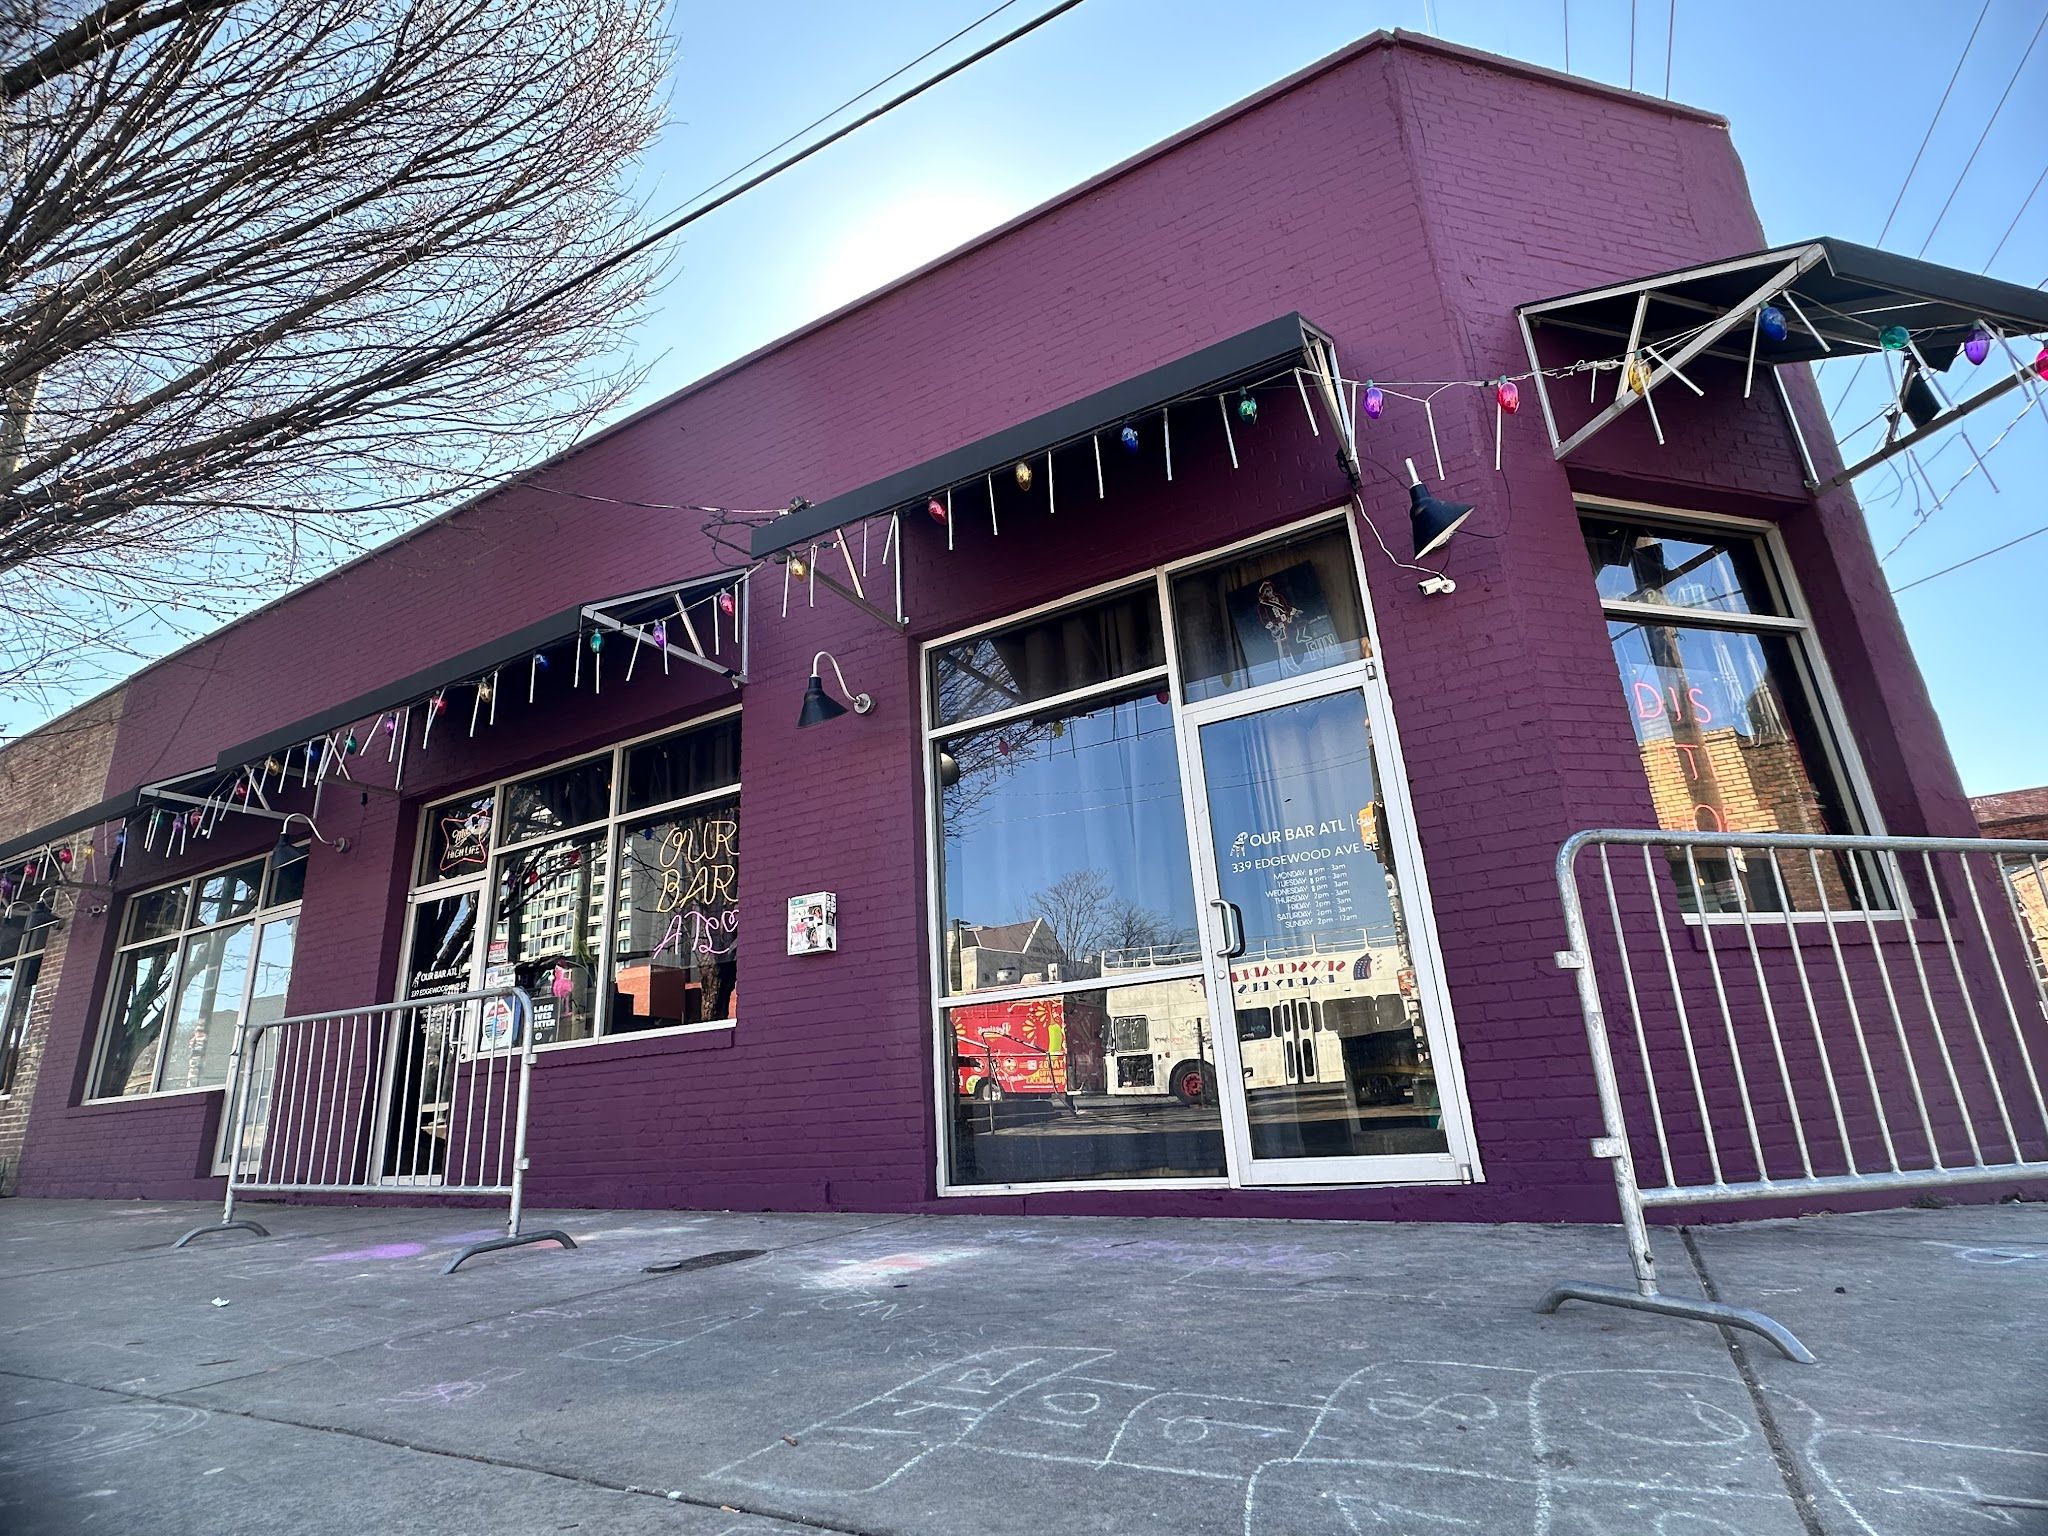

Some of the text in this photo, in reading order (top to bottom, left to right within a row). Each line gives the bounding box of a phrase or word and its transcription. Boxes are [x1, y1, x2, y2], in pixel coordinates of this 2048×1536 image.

[1634, 682, 1712, 724] DIS
[452, 828, 473, 847] Mill
[660, 820, 741, 868] OUR
[1249, 831, 1282, 847] OUR
[1285, 827, 1316, 842] BAR
[1319, 819, 1347, 836] ATL
[447, 845, 481, 860] HIGH LIFE
[1231, 841, 1380, 874] 339 EDGEWOOD AVE SE
[656, 864, 739, 913] BAR
[653, 910, 730, 959] ATL
[421, 967, 457, 982] OUR BAR ATL
[534, 1004, 554, 1013] LACK
[534, 1011, 552, 1021] IVES
[534, 1019, 556, 1028] ATTER
